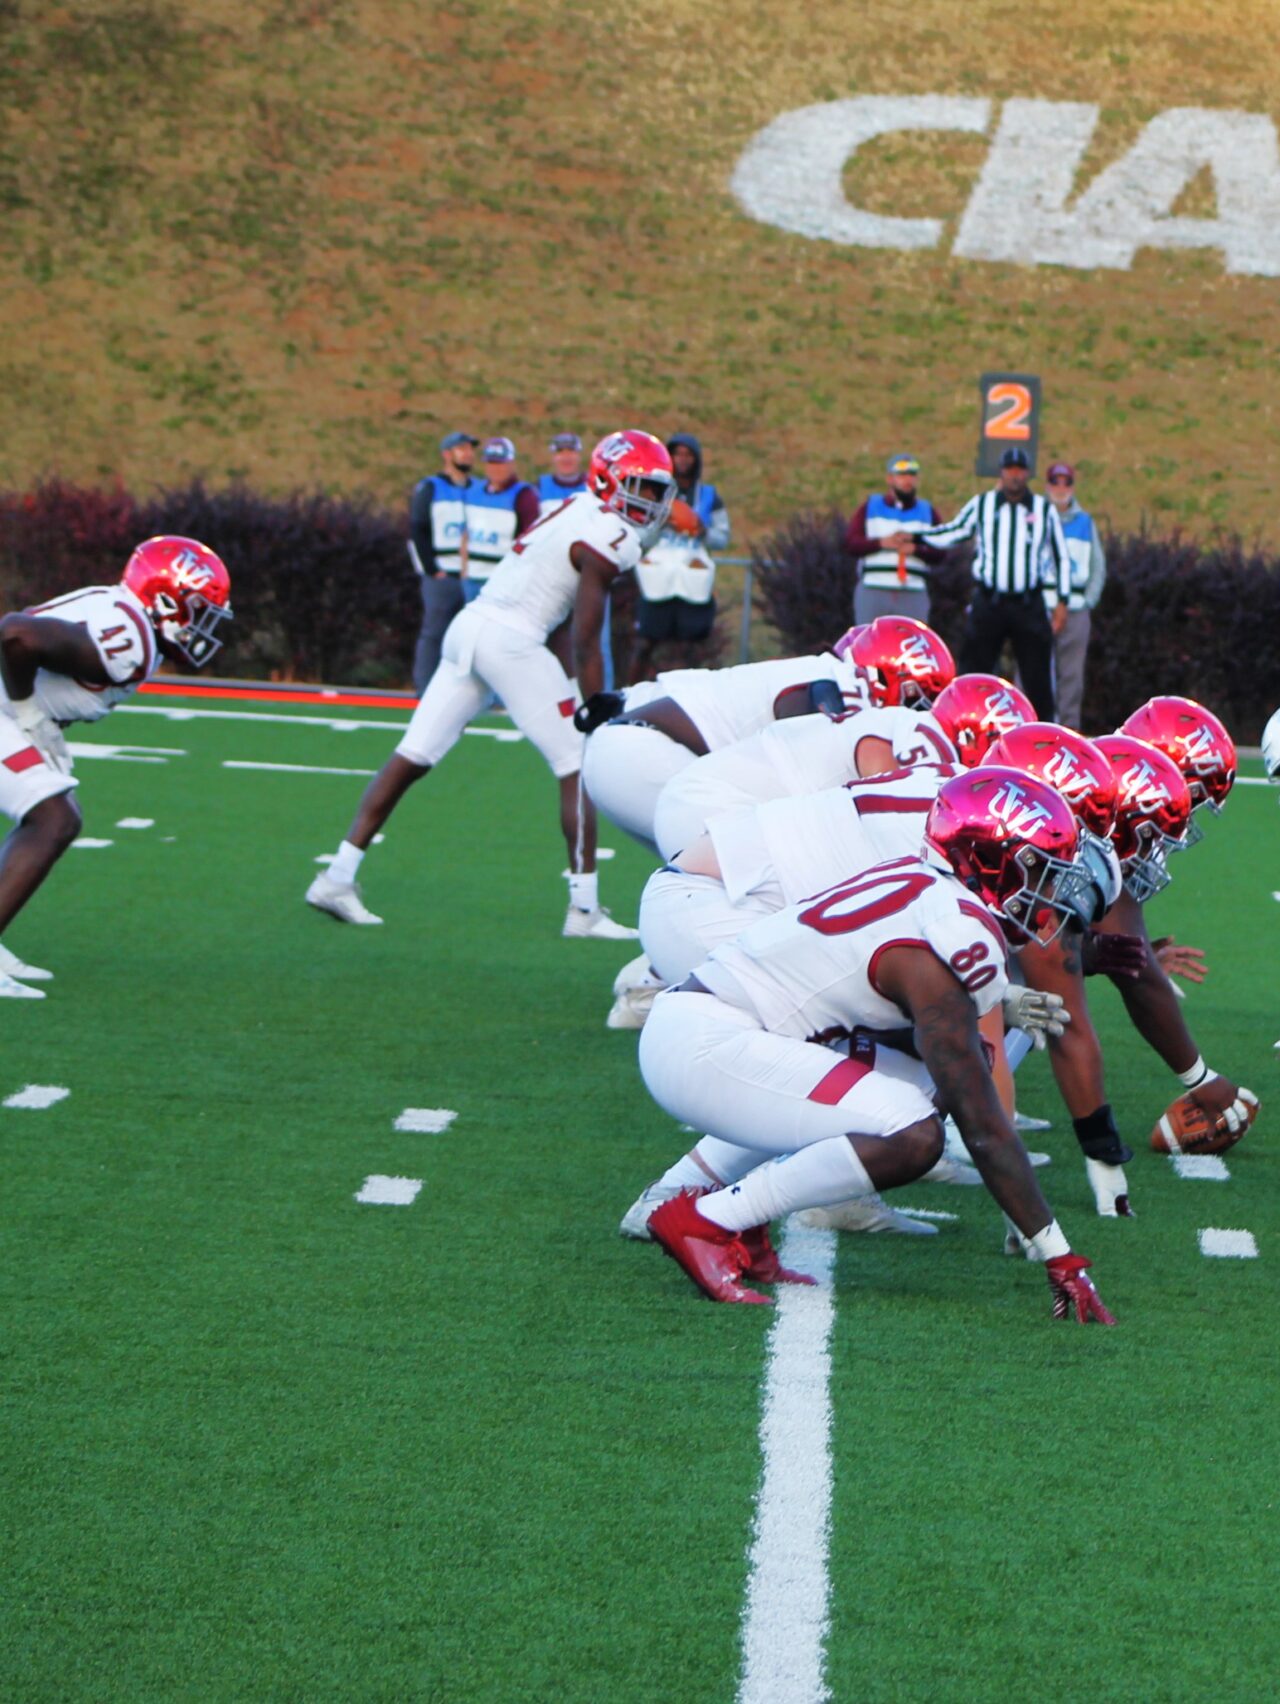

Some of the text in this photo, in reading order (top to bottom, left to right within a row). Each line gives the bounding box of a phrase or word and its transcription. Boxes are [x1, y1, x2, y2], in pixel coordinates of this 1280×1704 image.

[984, 382, 1032, 440] 2
[609, 528, 628, 550] 2
[98, 624, 134, 660] 42
[797, 856, 936, 936] 0
[950, 941, 998, 993] 80
